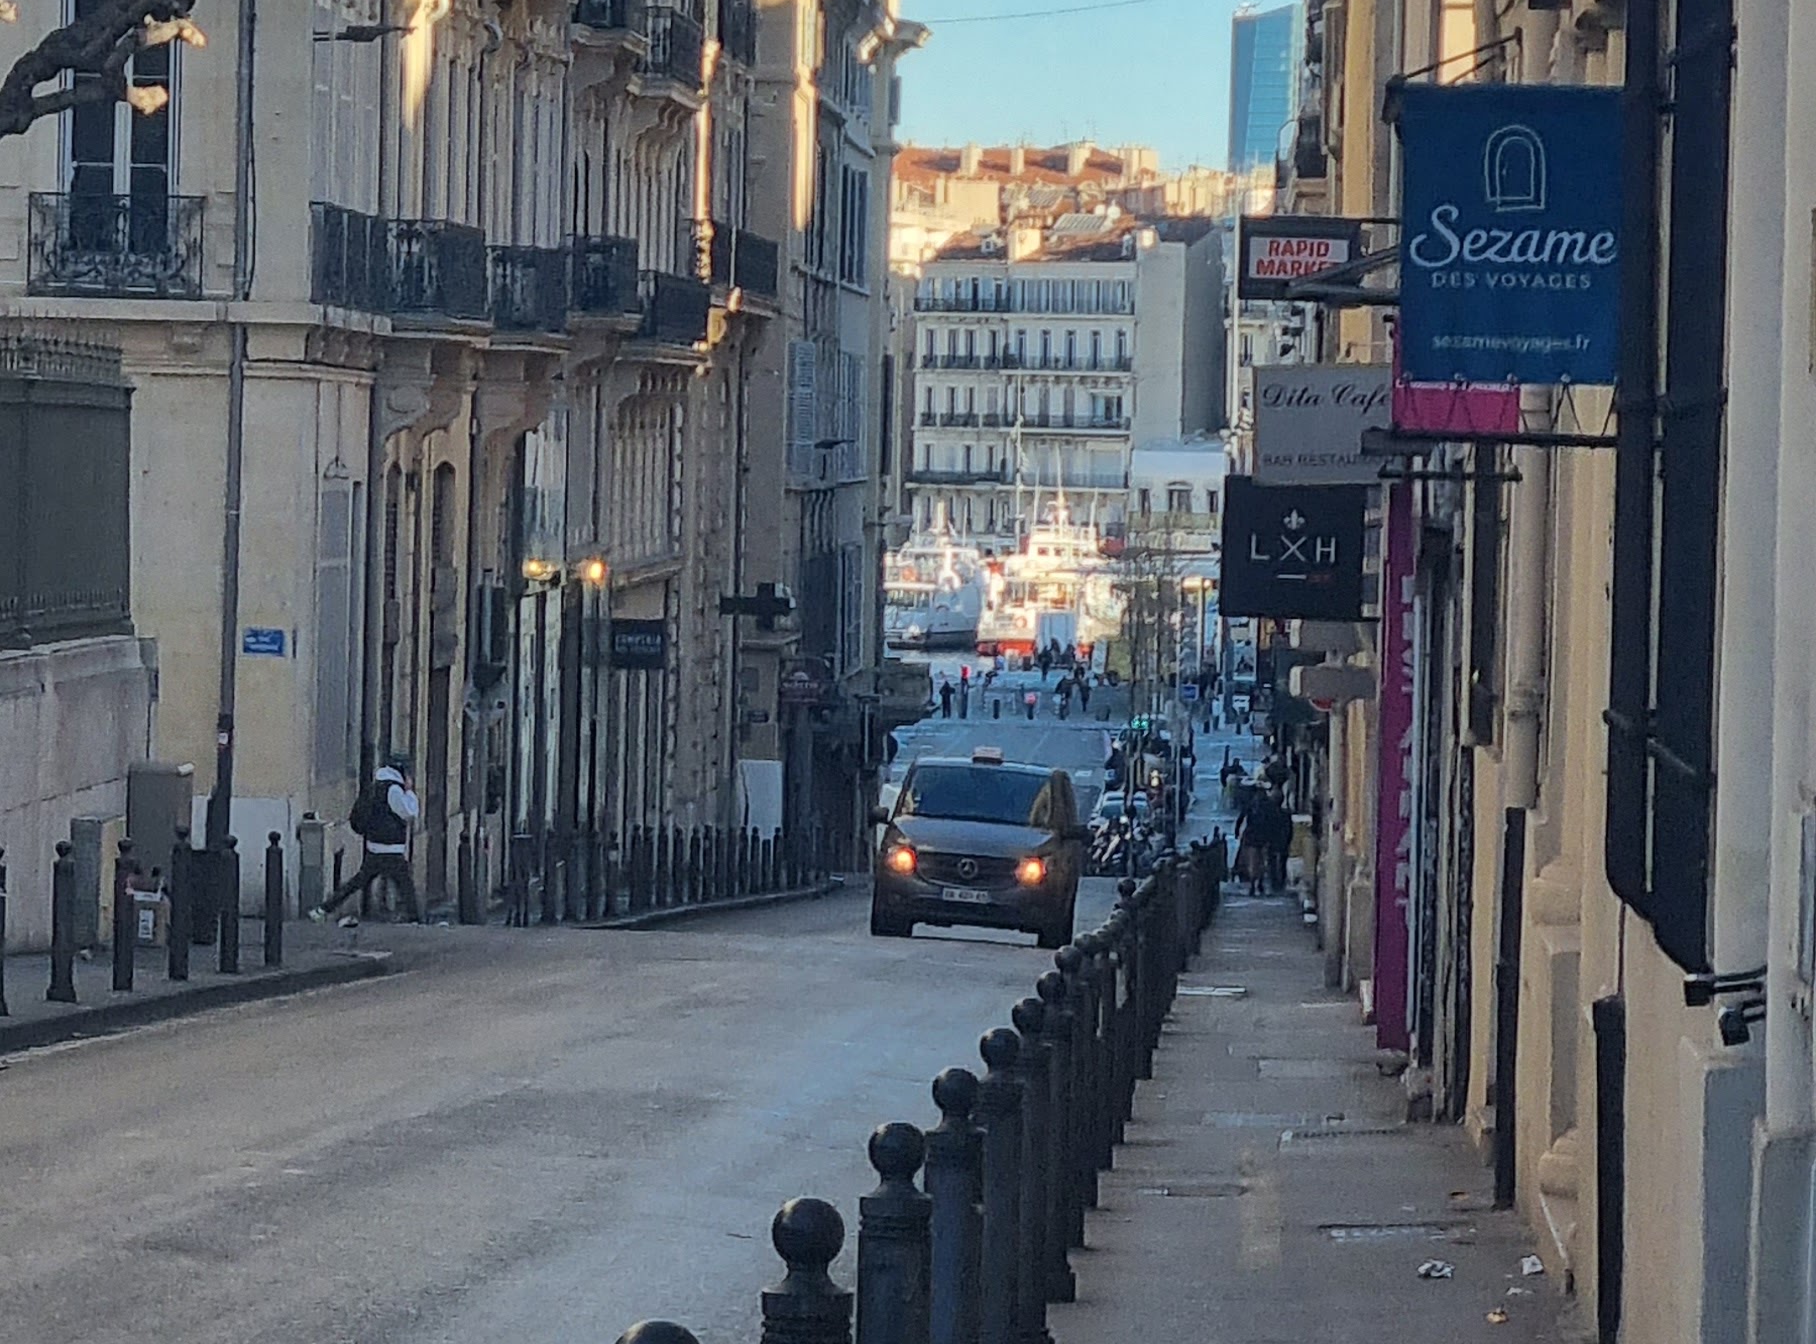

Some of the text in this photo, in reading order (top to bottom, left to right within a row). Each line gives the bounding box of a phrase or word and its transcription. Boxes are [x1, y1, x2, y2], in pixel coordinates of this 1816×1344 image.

[1409, 205, 1617, 267] Sezame
[1268, 240, 1330, 257] RAPID
[1431, 272, 1592, 289] DES VOYAGES
